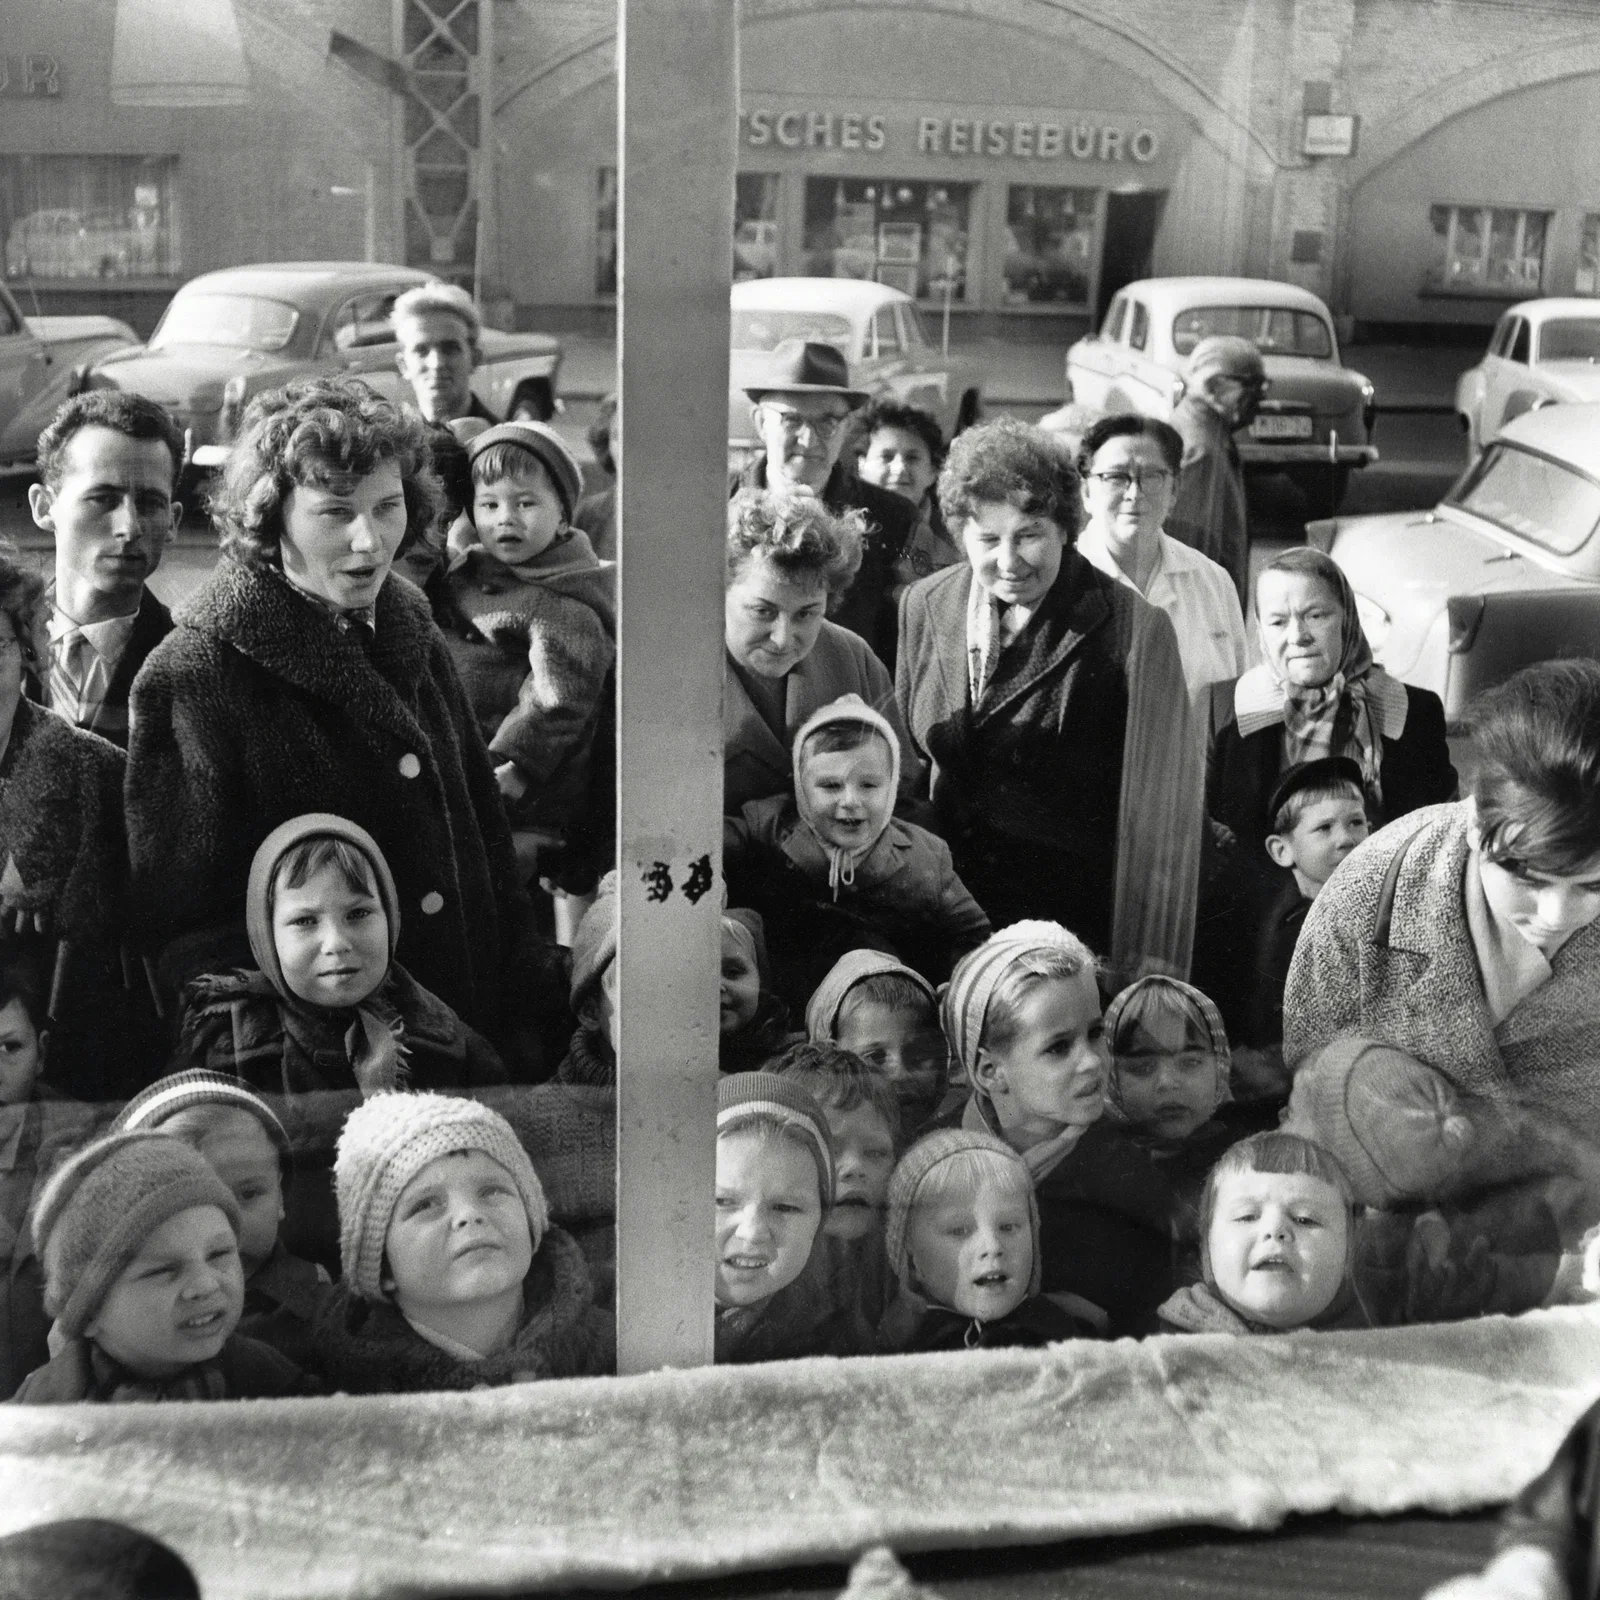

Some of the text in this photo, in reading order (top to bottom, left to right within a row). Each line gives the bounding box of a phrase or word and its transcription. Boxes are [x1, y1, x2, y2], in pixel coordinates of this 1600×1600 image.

[0, 54, 59, 94] R
[739, 108, 1160, 163] SCHES REISEBÜRO
